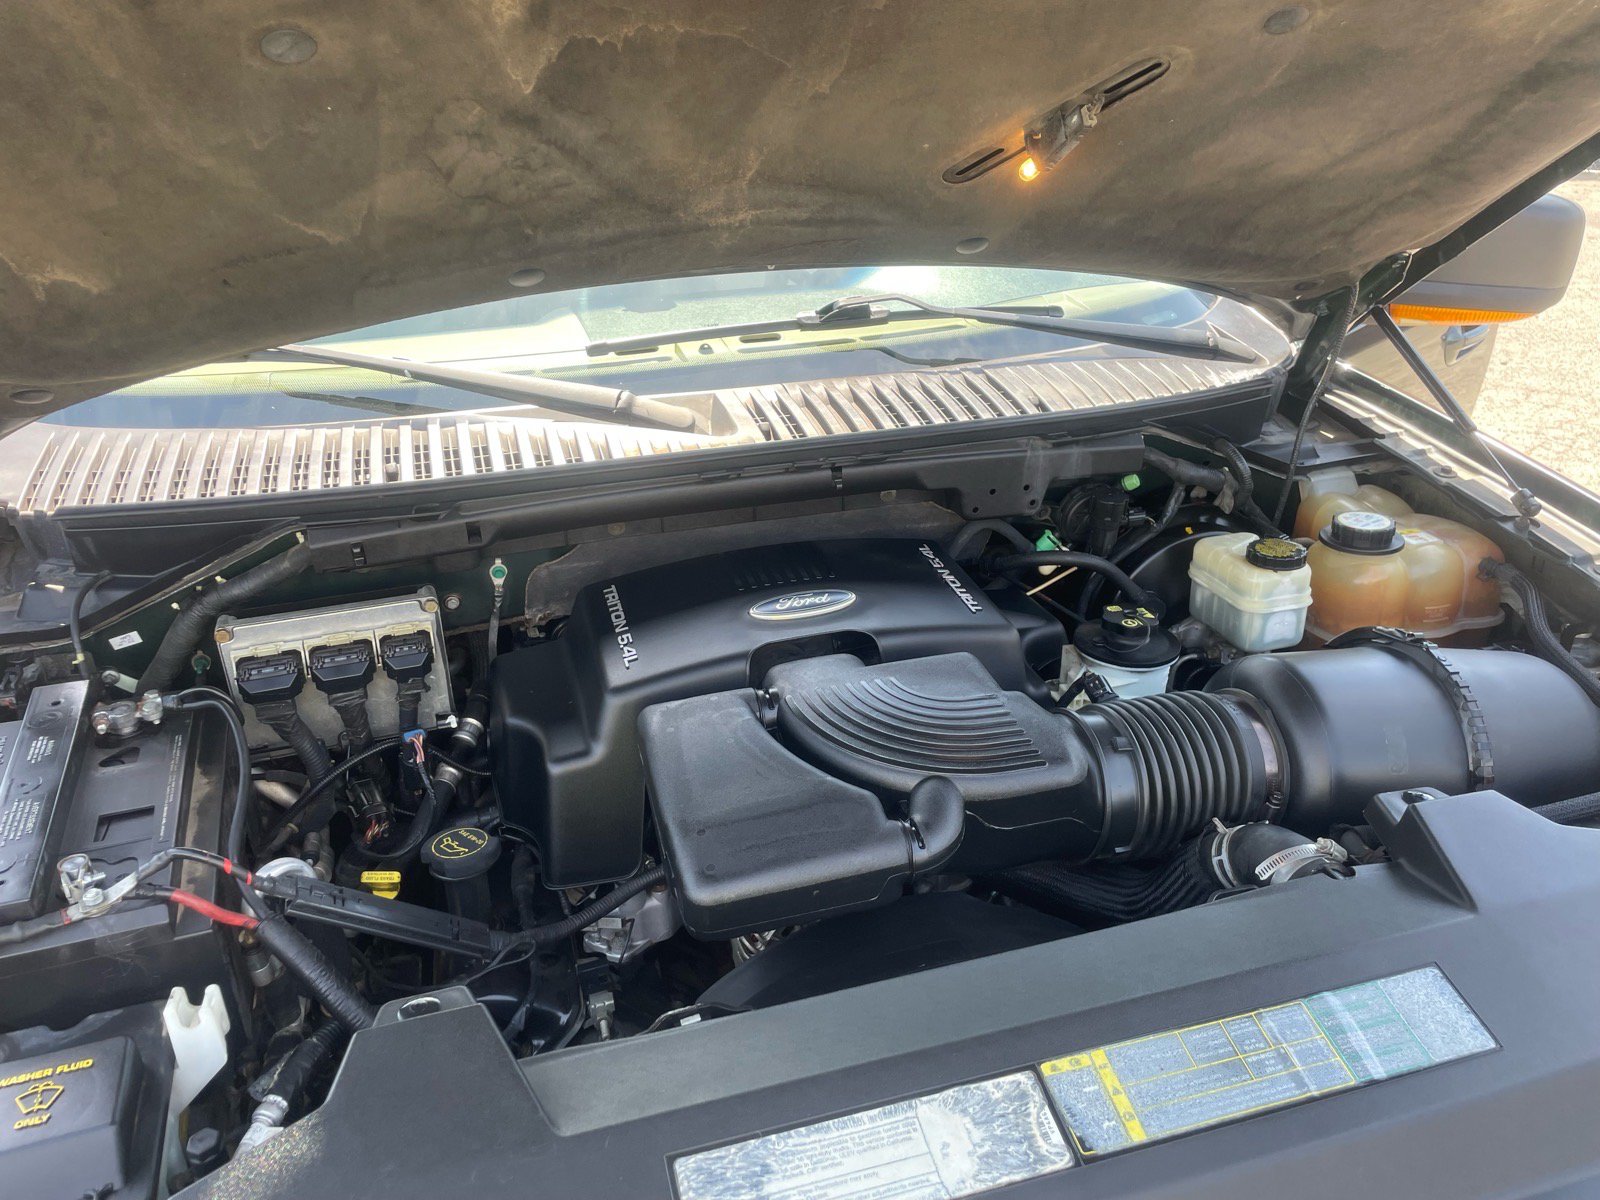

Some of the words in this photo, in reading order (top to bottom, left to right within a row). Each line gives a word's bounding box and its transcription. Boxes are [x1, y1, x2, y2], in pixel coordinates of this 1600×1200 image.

[919, 543, 944, 568] 5.4L
[775, 593, 831, 610] Ford
[937, 569, 983, 613] TRITON
[603, 584, 629, 633] TRITON
[617, 633, 639, 669] 5.4L
[55, 1058, 95, 1075] FLUID
[13, 1112, 52, 1130] ONLY
